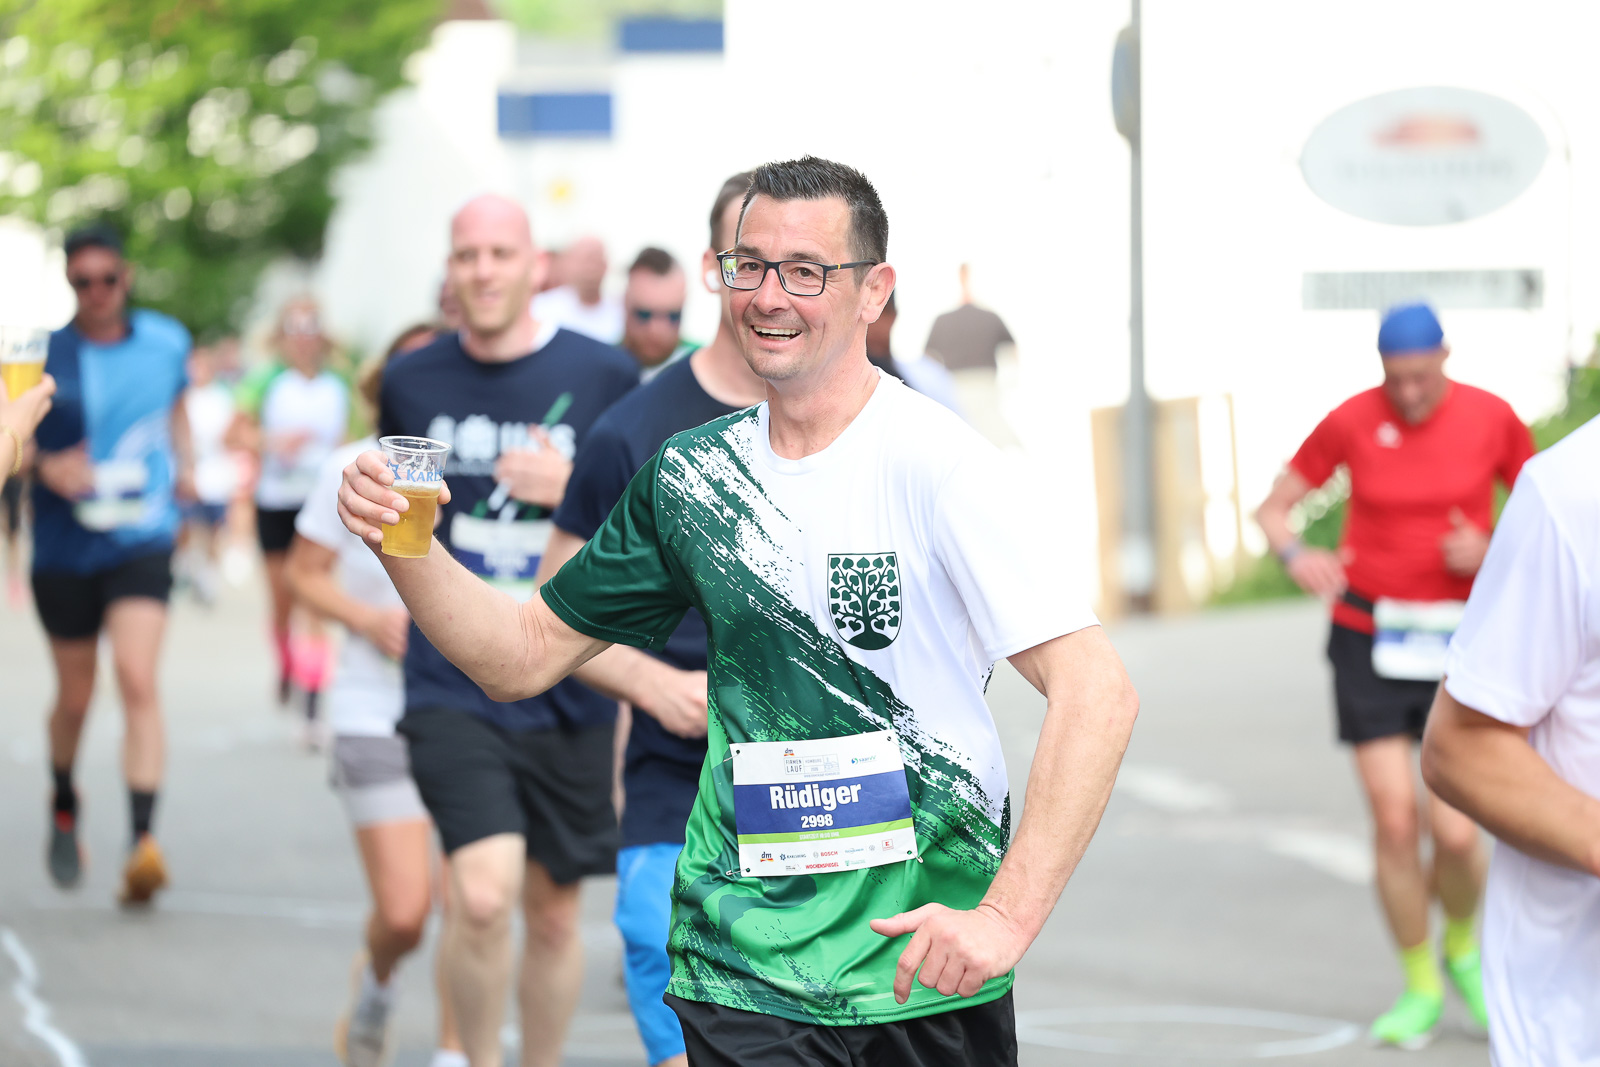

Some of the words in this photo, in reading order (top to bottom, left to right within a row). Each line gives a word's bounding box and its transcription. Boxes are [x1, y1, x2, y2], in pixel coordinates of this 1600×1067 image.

[786, 765, 803, 773] LAUF
[769, 783, 862, 811] Rüdiger
[800, 814, 834, 829] 2998
[761, 851, 772, 859] dm
